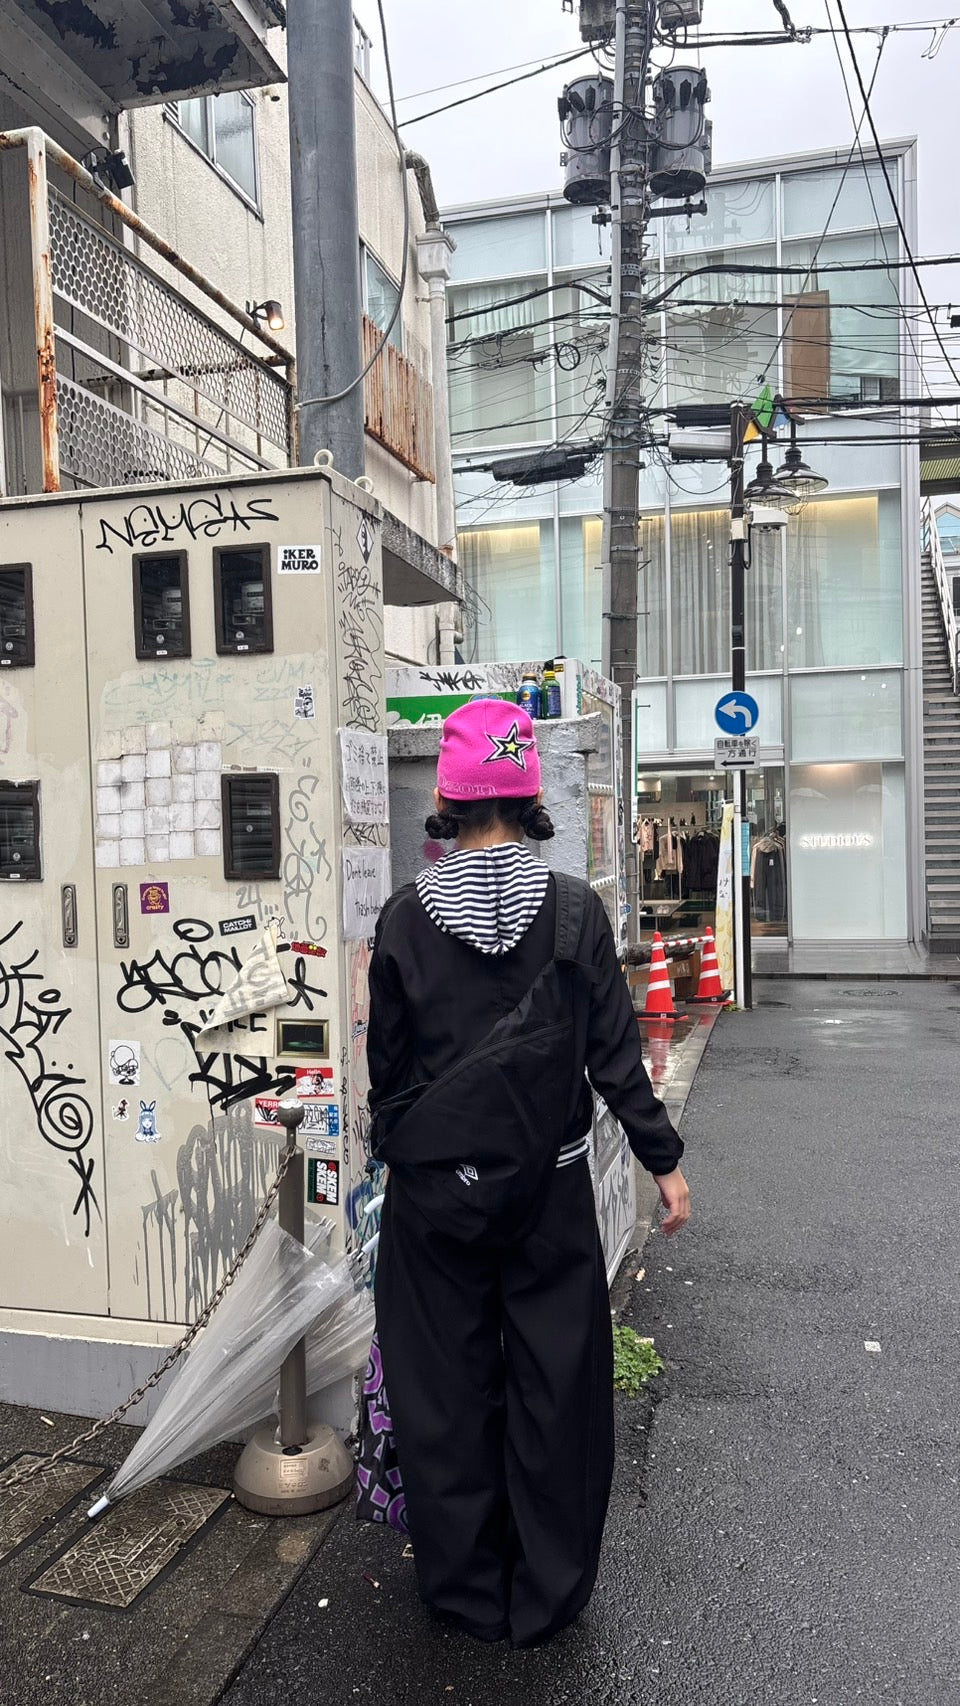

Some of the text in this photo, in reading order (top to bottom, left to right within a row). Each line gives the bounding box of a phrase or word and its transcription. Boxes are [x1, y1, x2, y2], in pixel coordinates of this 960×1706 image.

[281, 560, 319, 571] MURO
[717, 749, 757, 759] 一方通行
[316, 1161, 328, 1196] SKEM
[326, 1169, 338, 1204] SKEM
